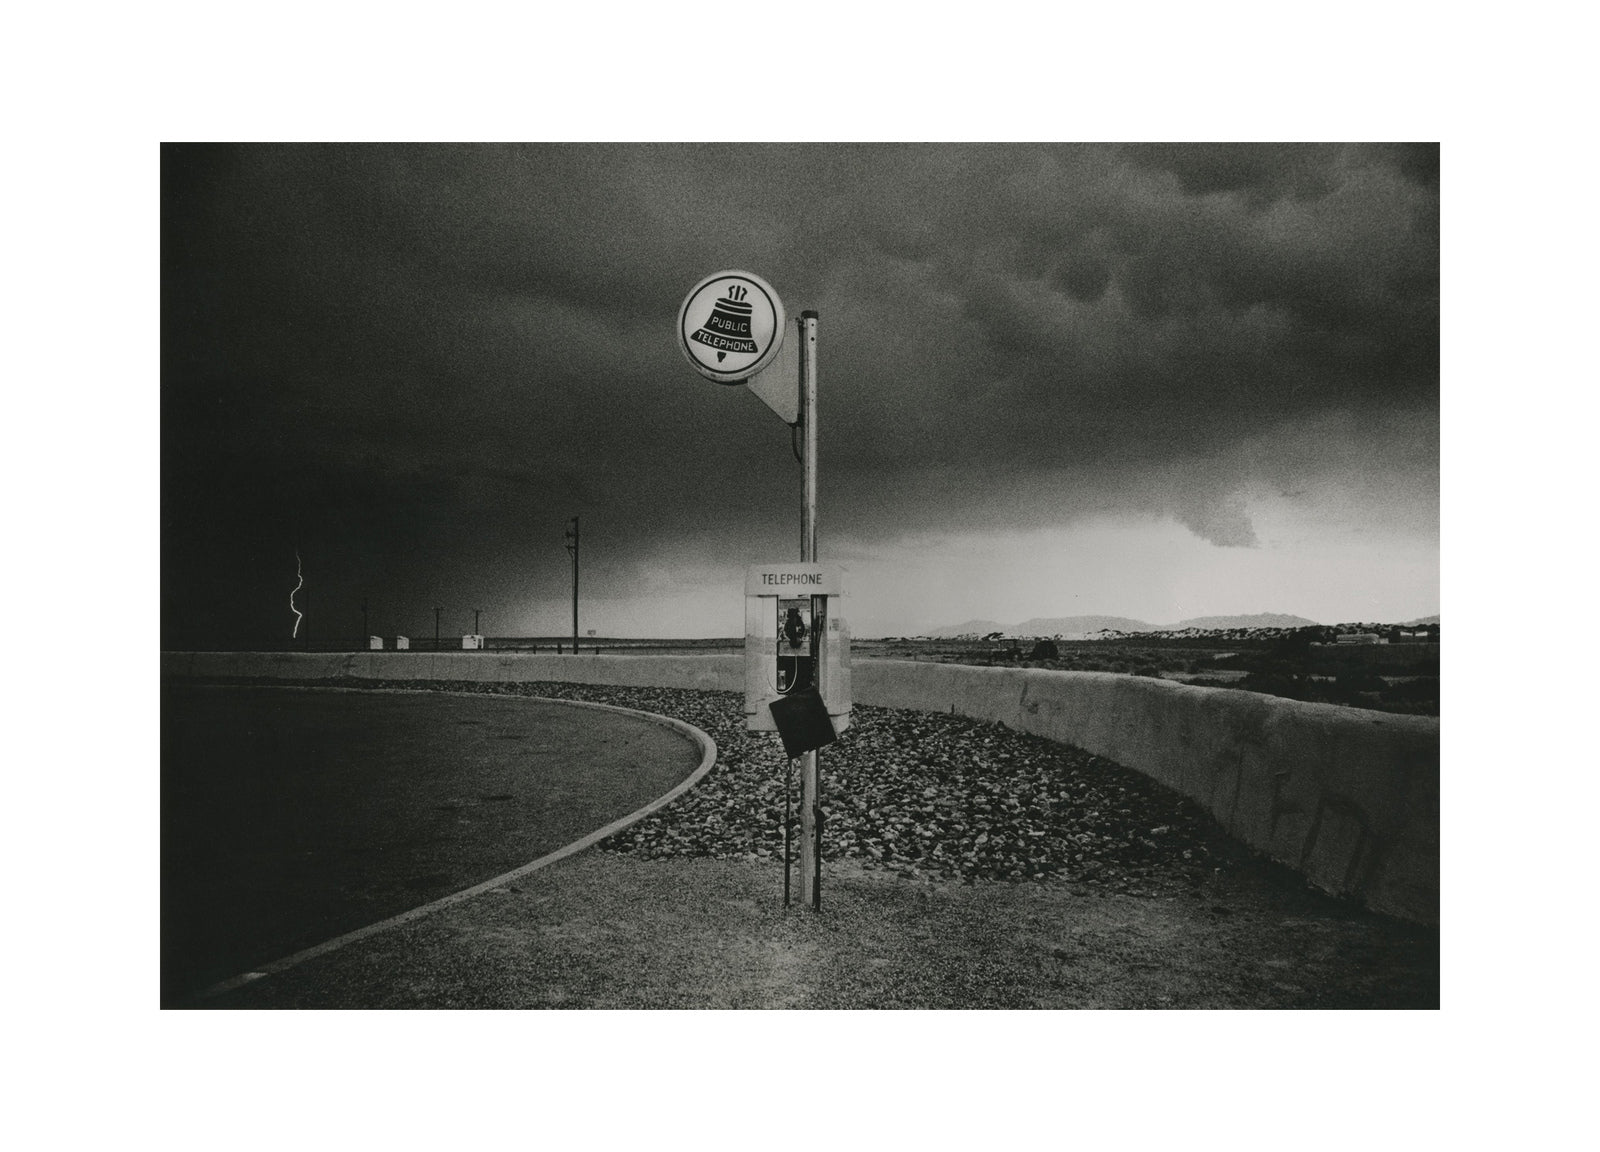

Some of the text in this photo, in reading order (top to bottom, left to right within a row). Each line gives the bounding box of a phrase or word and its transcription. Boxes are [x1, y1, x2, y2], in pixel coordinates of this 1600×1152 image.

[711, 316, 748, 332] PUBLIC
[698, 331, 754, 351] TELEPHONE
[762, 573, 823, 585] TELEPHONE
